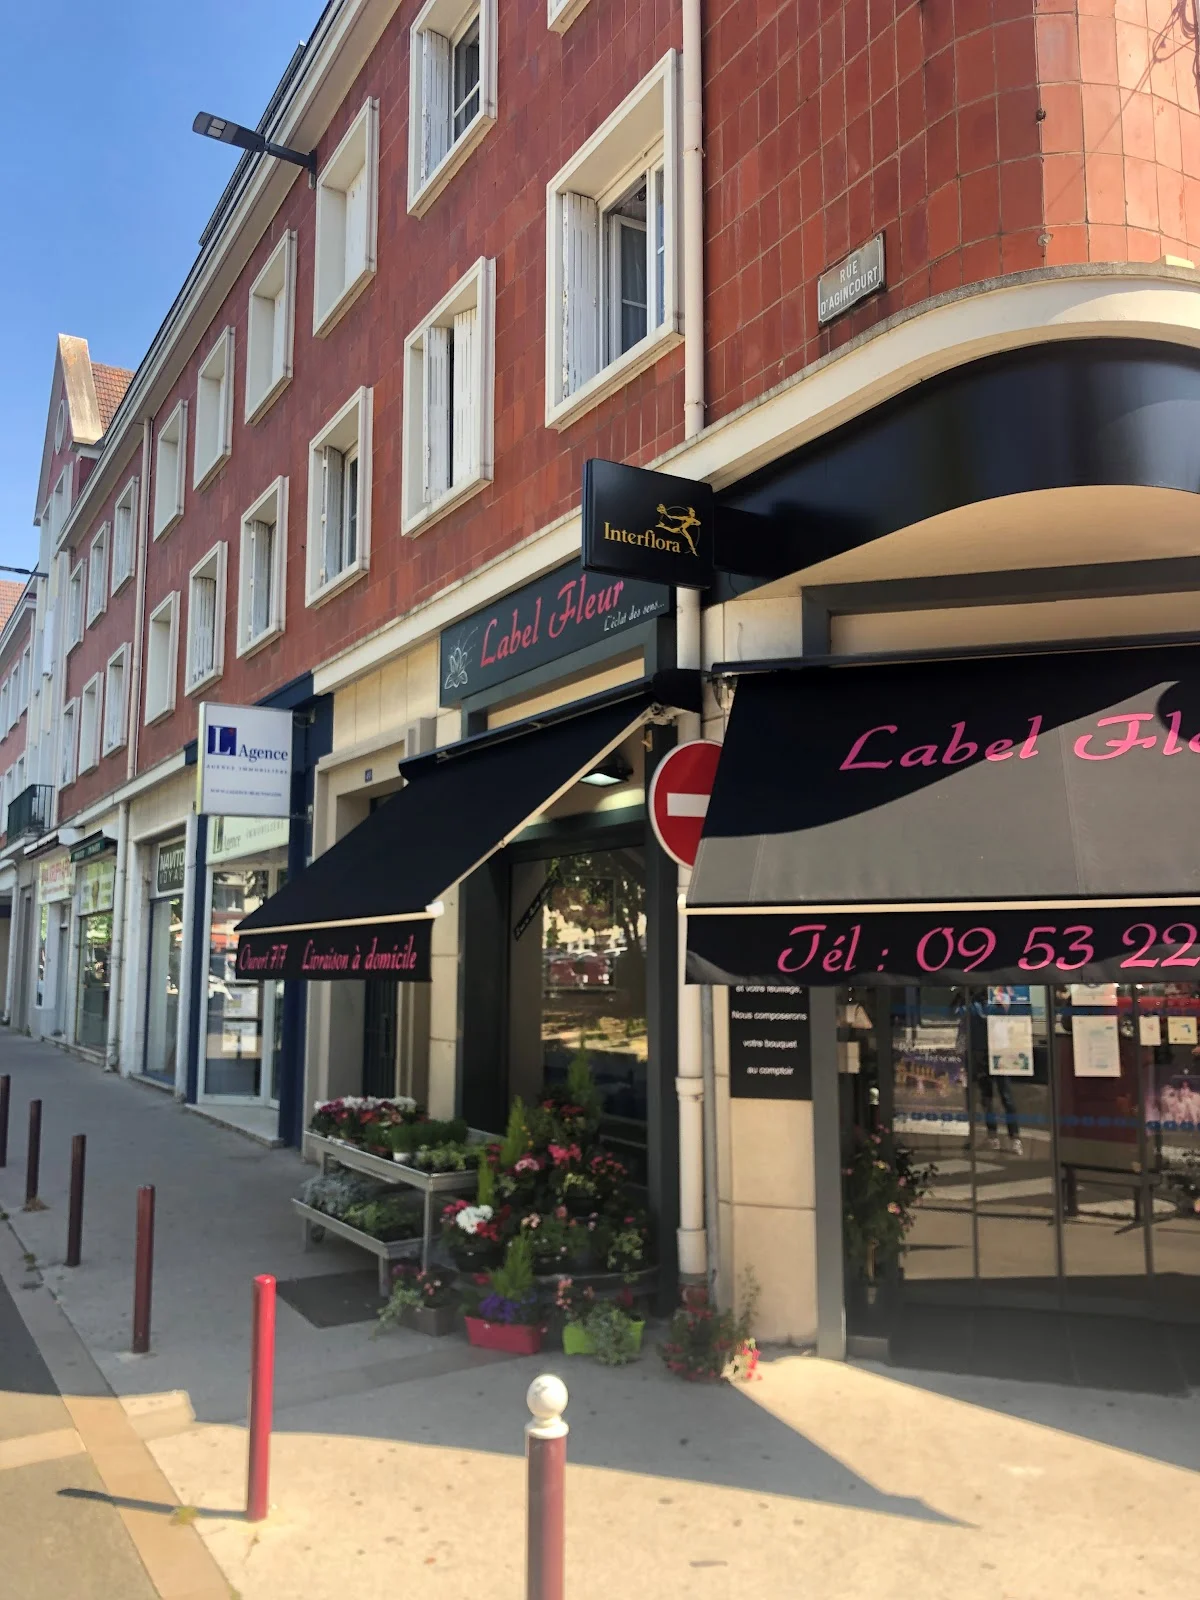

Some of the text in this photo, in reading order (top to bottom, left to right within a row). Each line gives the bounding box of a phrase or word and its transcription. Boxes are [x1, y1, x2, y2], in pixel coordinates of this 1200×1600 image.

[839, 260, 858, 283] RUE
[820, 265, 878, 316] D'AGINCOURT
[604, 521, 681, 553] Interflora
[480, 573, 625, 668] Label Fleur
[628, 605, 642, 622] des
[839, 715, 1044, 771] Label
[239, 944, 269, 971] Ouvert
[301, 939, 349, 971] Livraison
[352, 945, 361, 970] à
[364, 934, 417, 971] domicile
[777, 924, 864, 973] Tél
[916, 927, 997, 973] 09
[1018, 925, 1095, 971] 53
[1119, 923, 1200, 969] 22
[732, 1010, 808, 1021] Nous composerons
[743, 1039, 797, 1050] votre bouquet
[747, 1066, 794, 1077] au comptoir
